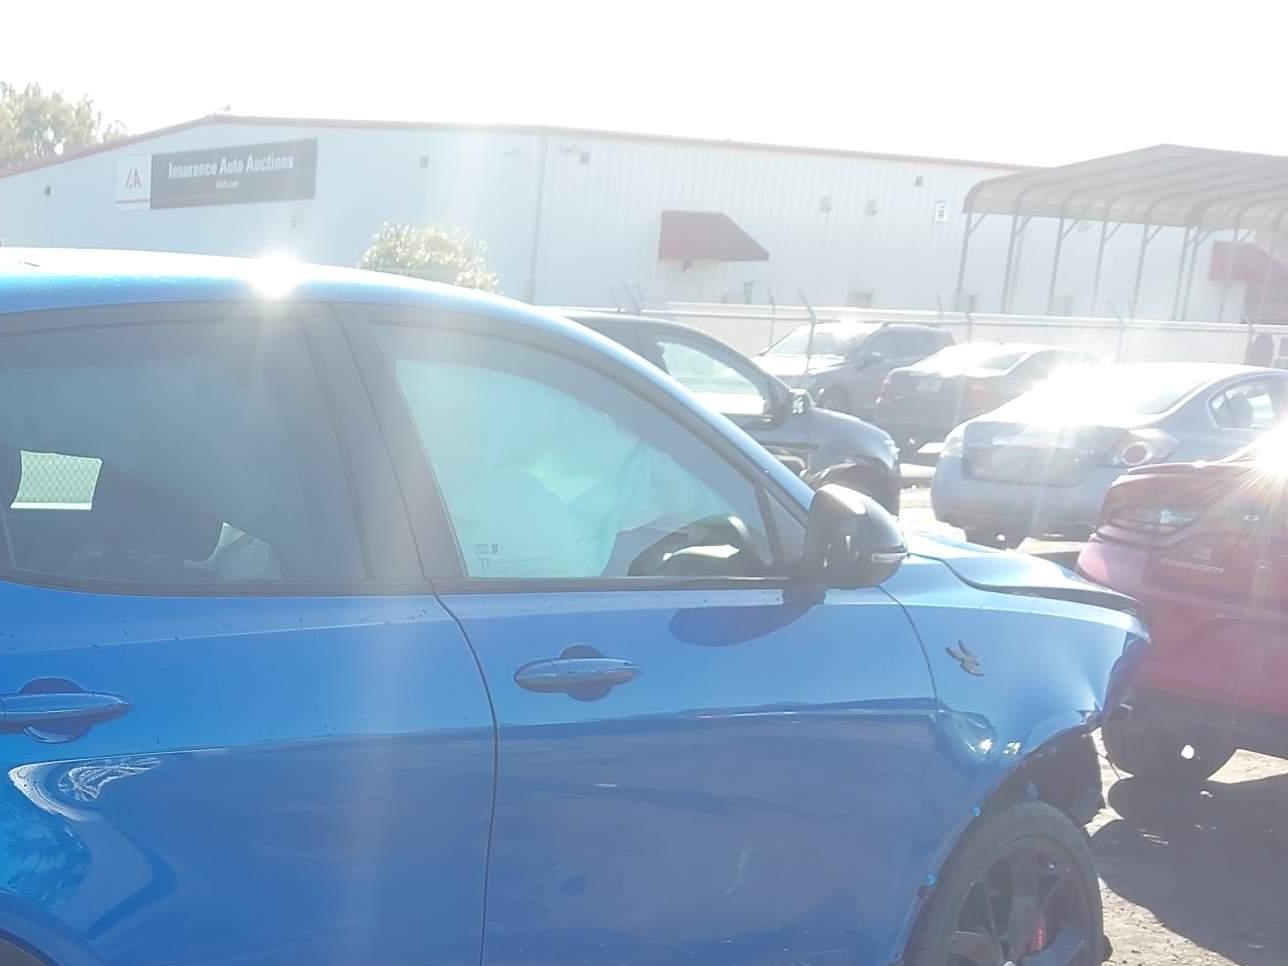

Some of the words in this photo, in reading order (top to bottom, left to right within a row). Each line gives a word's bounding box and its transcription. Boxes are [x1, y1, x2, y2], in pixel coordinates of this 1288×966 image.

[168, 162, 217, 179] Insurance
[219, 157, 244, 176] Auto
[245, 153, 295, 173] Auctions
